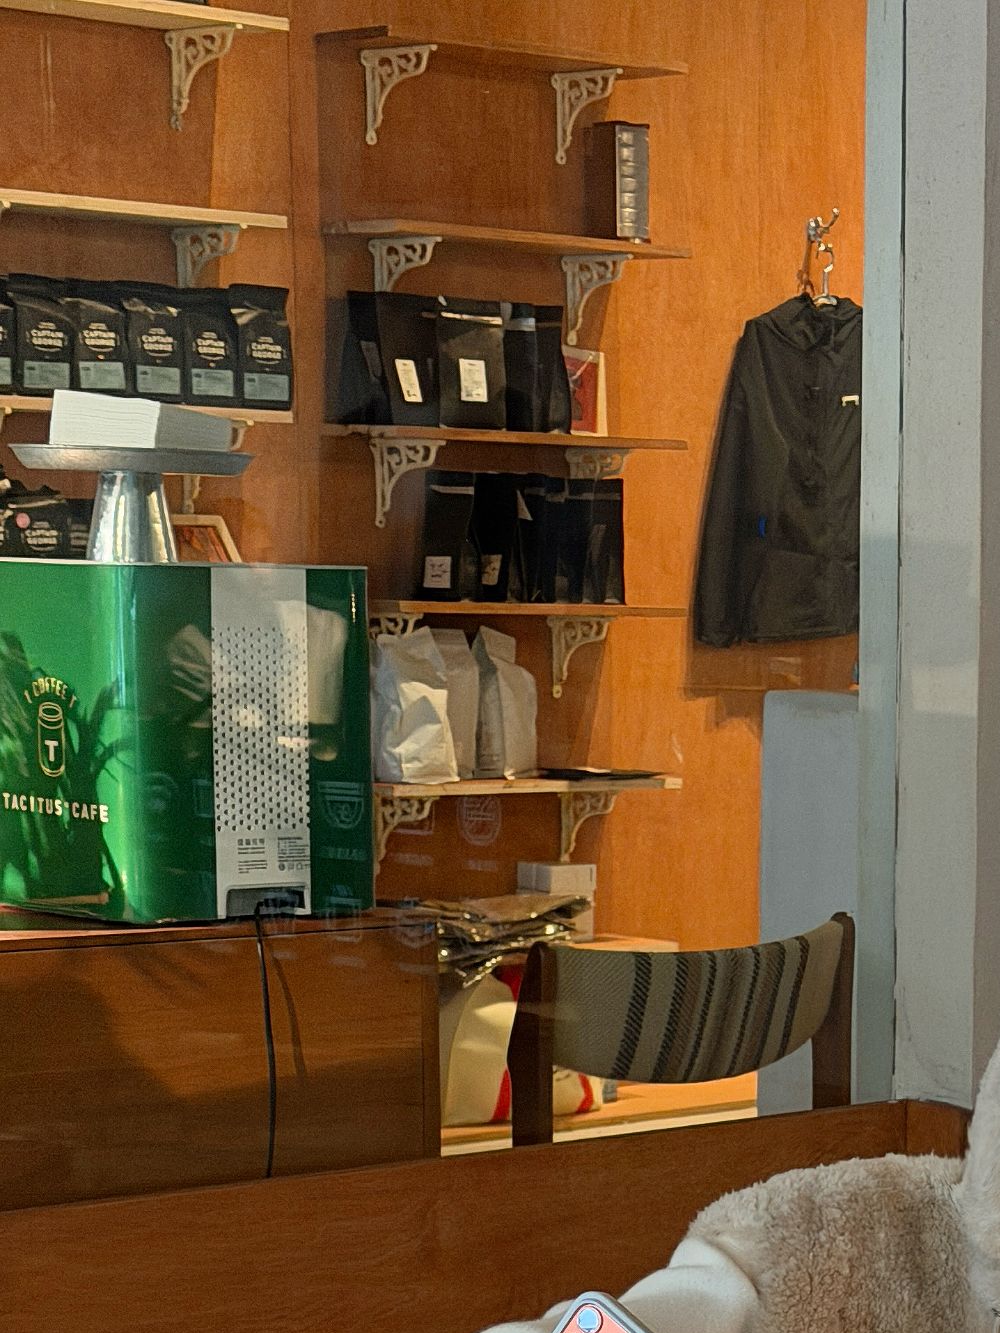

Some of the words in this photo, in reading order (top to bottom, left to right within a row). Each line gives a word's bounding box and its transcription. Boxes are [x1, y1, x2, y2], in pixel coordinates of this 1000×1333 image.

[32, 676, 69, 700] COFFEE
[44, 739, 59, 762] T
[71, 801, 109, 823] CAFE
